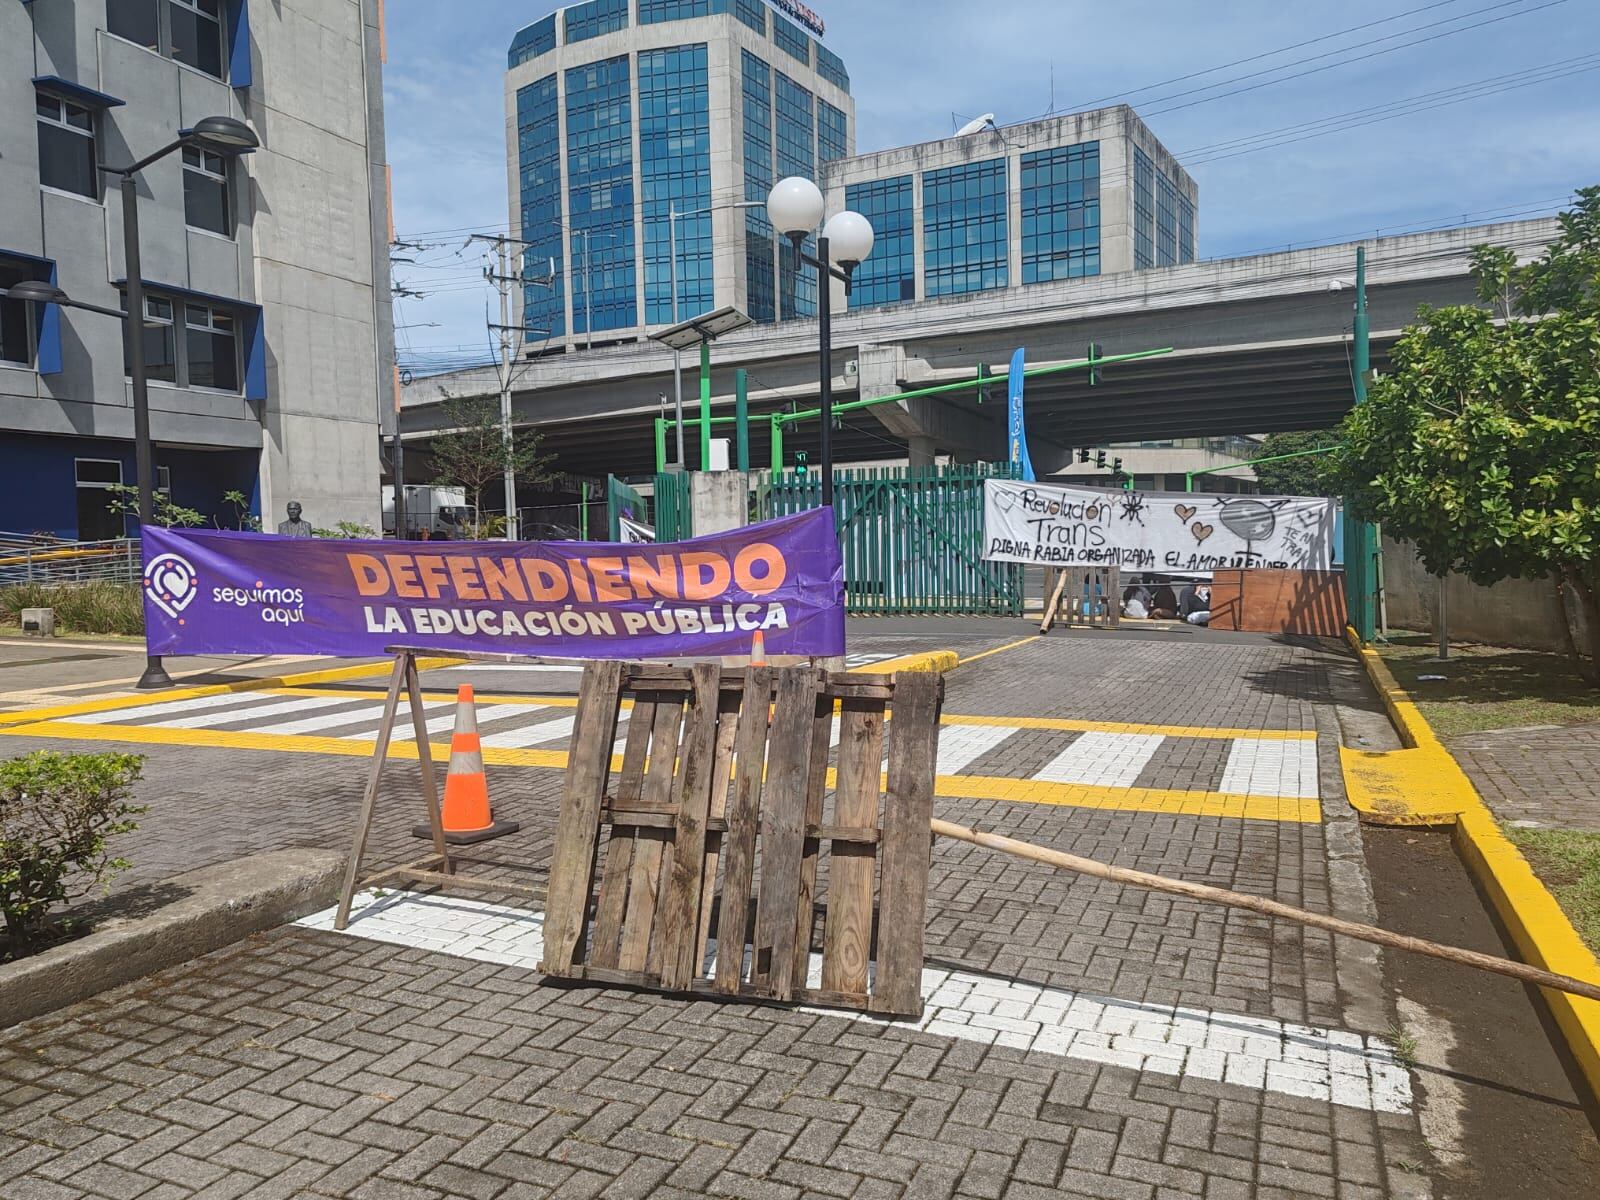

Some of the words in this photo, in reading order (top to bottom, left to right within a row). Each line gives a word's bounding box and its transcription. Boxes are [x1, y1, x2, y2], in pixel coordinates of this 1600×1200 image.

[1020, 488, 1112, 528] Revolución
[1027, 517, 1106, 547] Trans
[989, 538, 1032, 558] DIGNA
[1034, 545, 1075, 561] RABIA
[1077, 546, 1156, 568] ORGANIZADA
[1165, 551, 1185, 567] EL
[1186, 553, 1227, 570] AMOR
[346, 542, 787, 603] DEFENDIENDO
[212, 581, 304, 607] seguimos
[261, 604, 305, 626] aquí
[363, 606, 407, 633] LA
[410, 604, 618, 636] EDUCACIÓN
[620, 600, 790, 636] PÚBLICA
